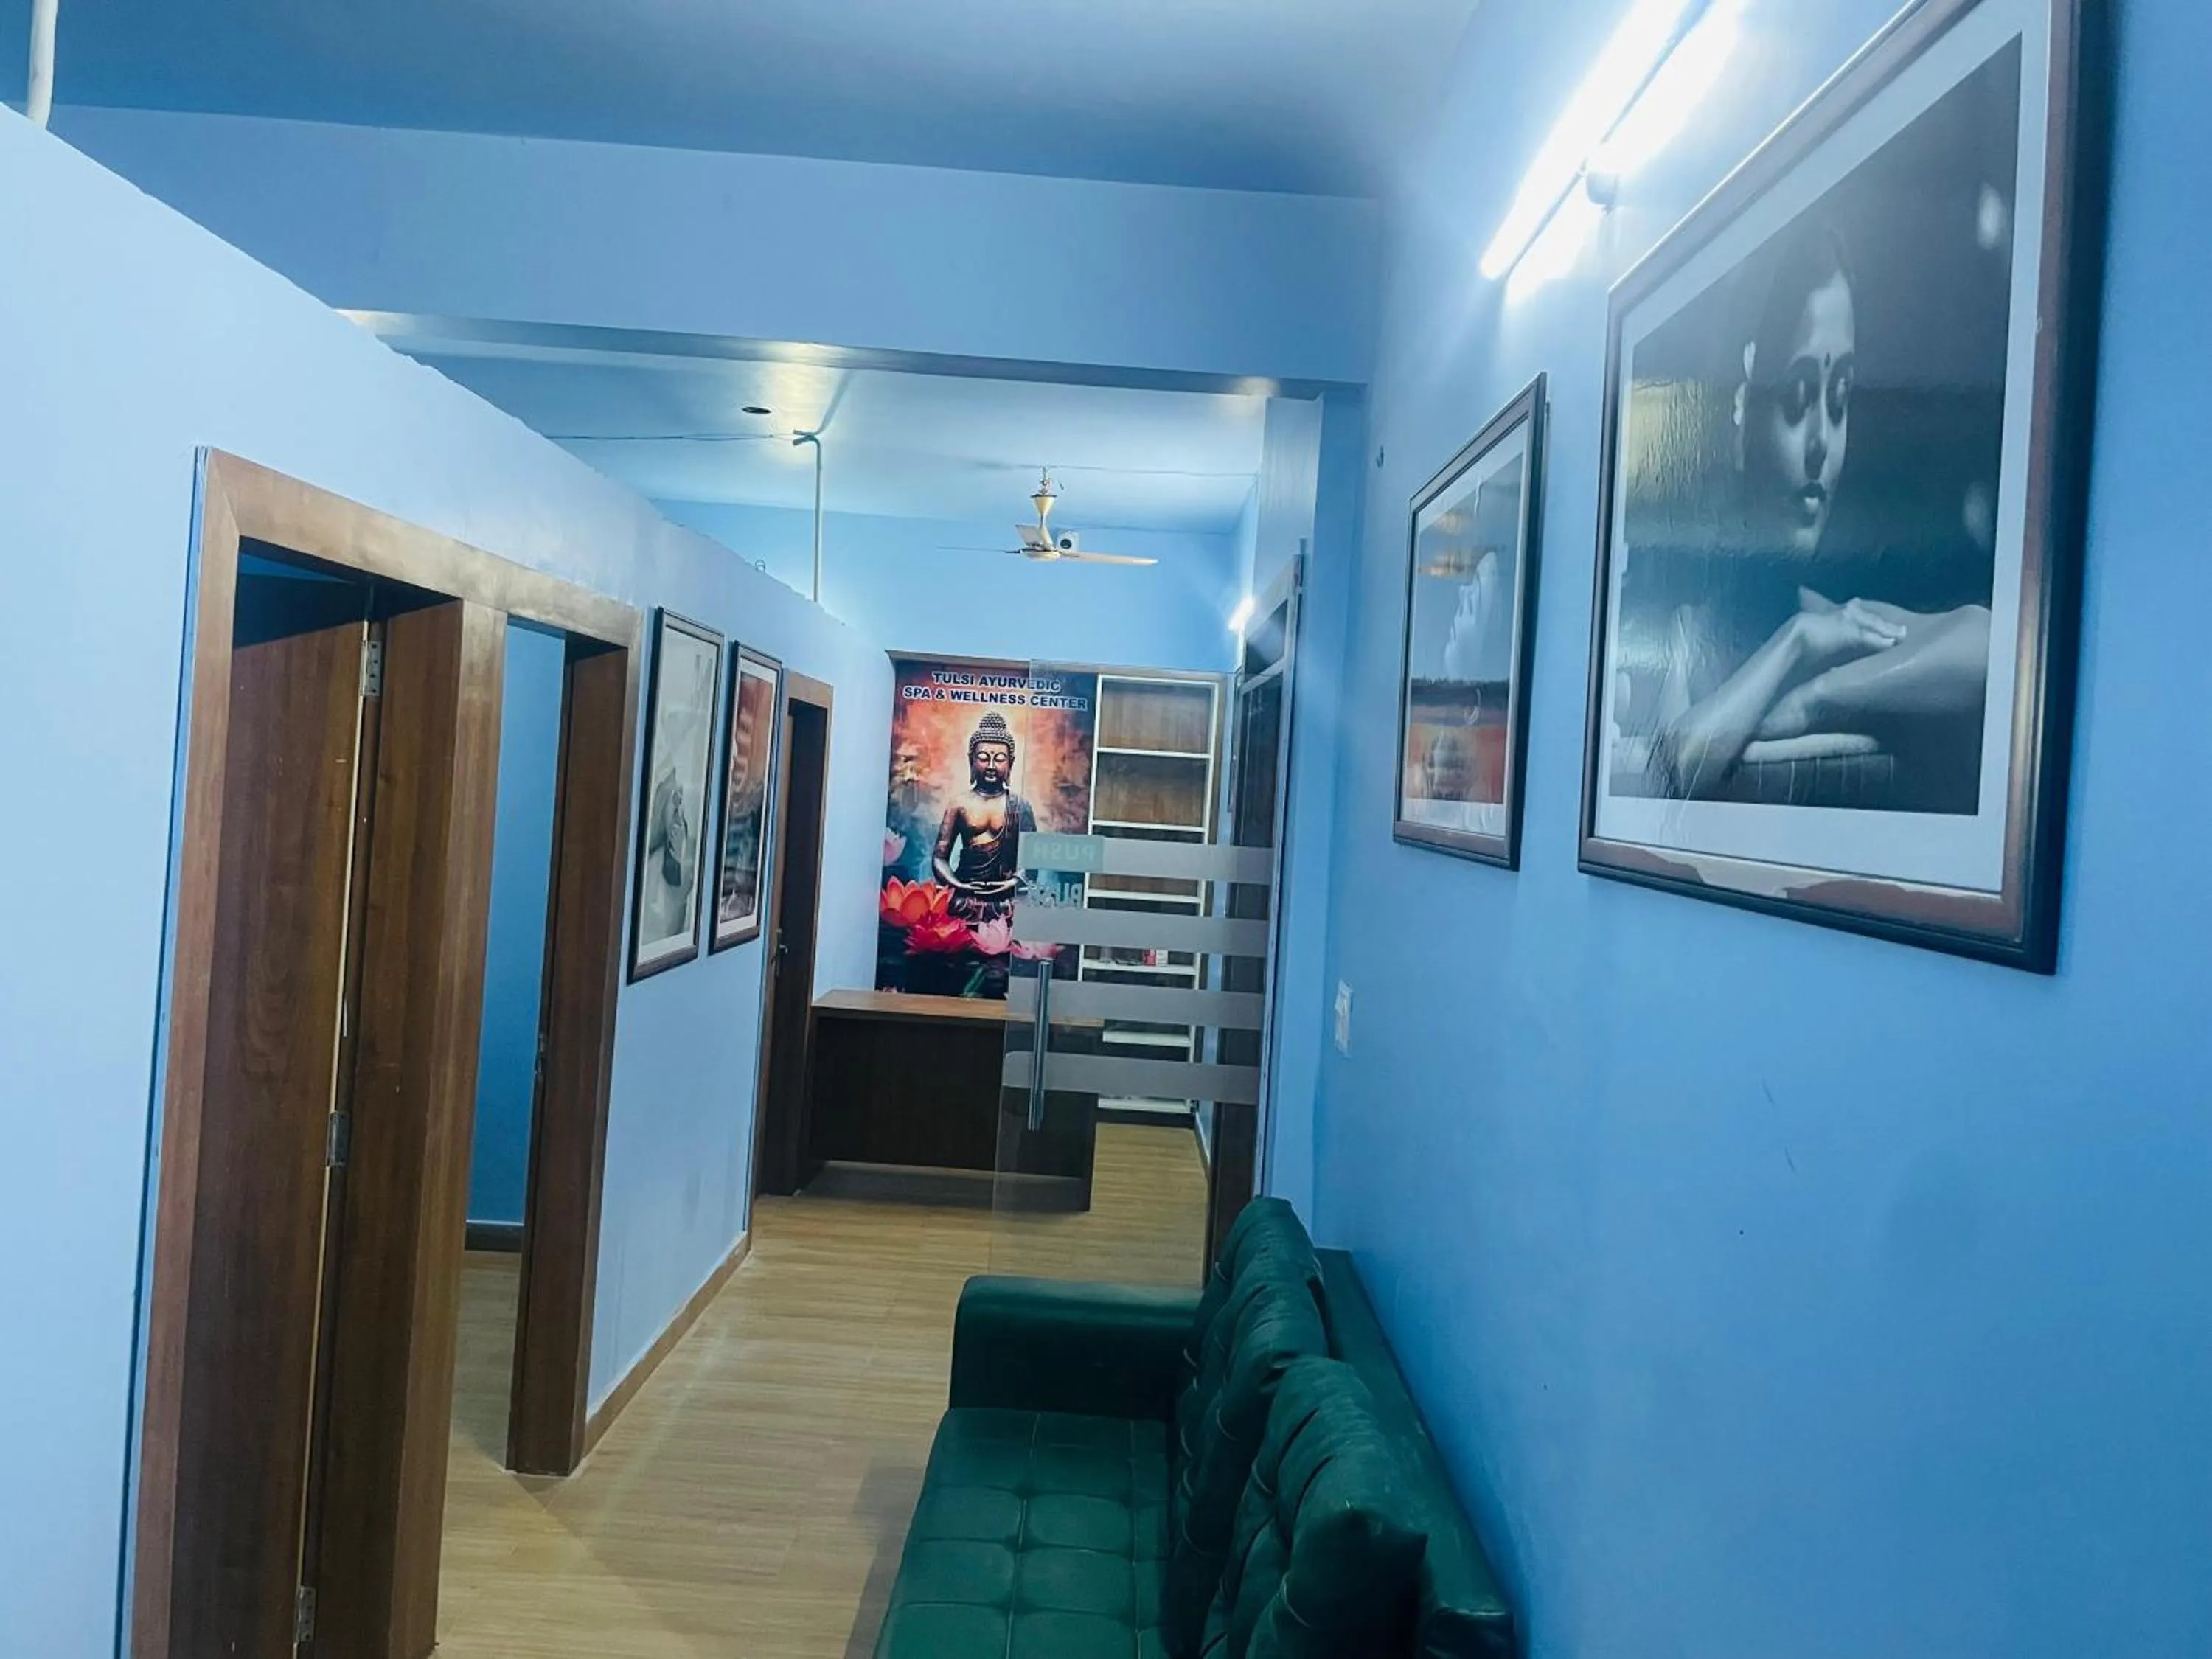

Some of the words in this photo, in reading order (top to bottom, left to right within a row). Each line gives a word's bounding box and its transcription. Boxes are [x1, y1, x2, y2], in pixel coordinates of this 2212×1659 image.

[933, 672, 974, 685] TULSI
[978, 675, 1060, 691] AYURVEDIC
[904, 686, 931, 698] SPA
[936, 689, 945, 700] &
[950, 689, 1026, 705] WELLNESS
[1030, 695, 1086, 709] CENTER
